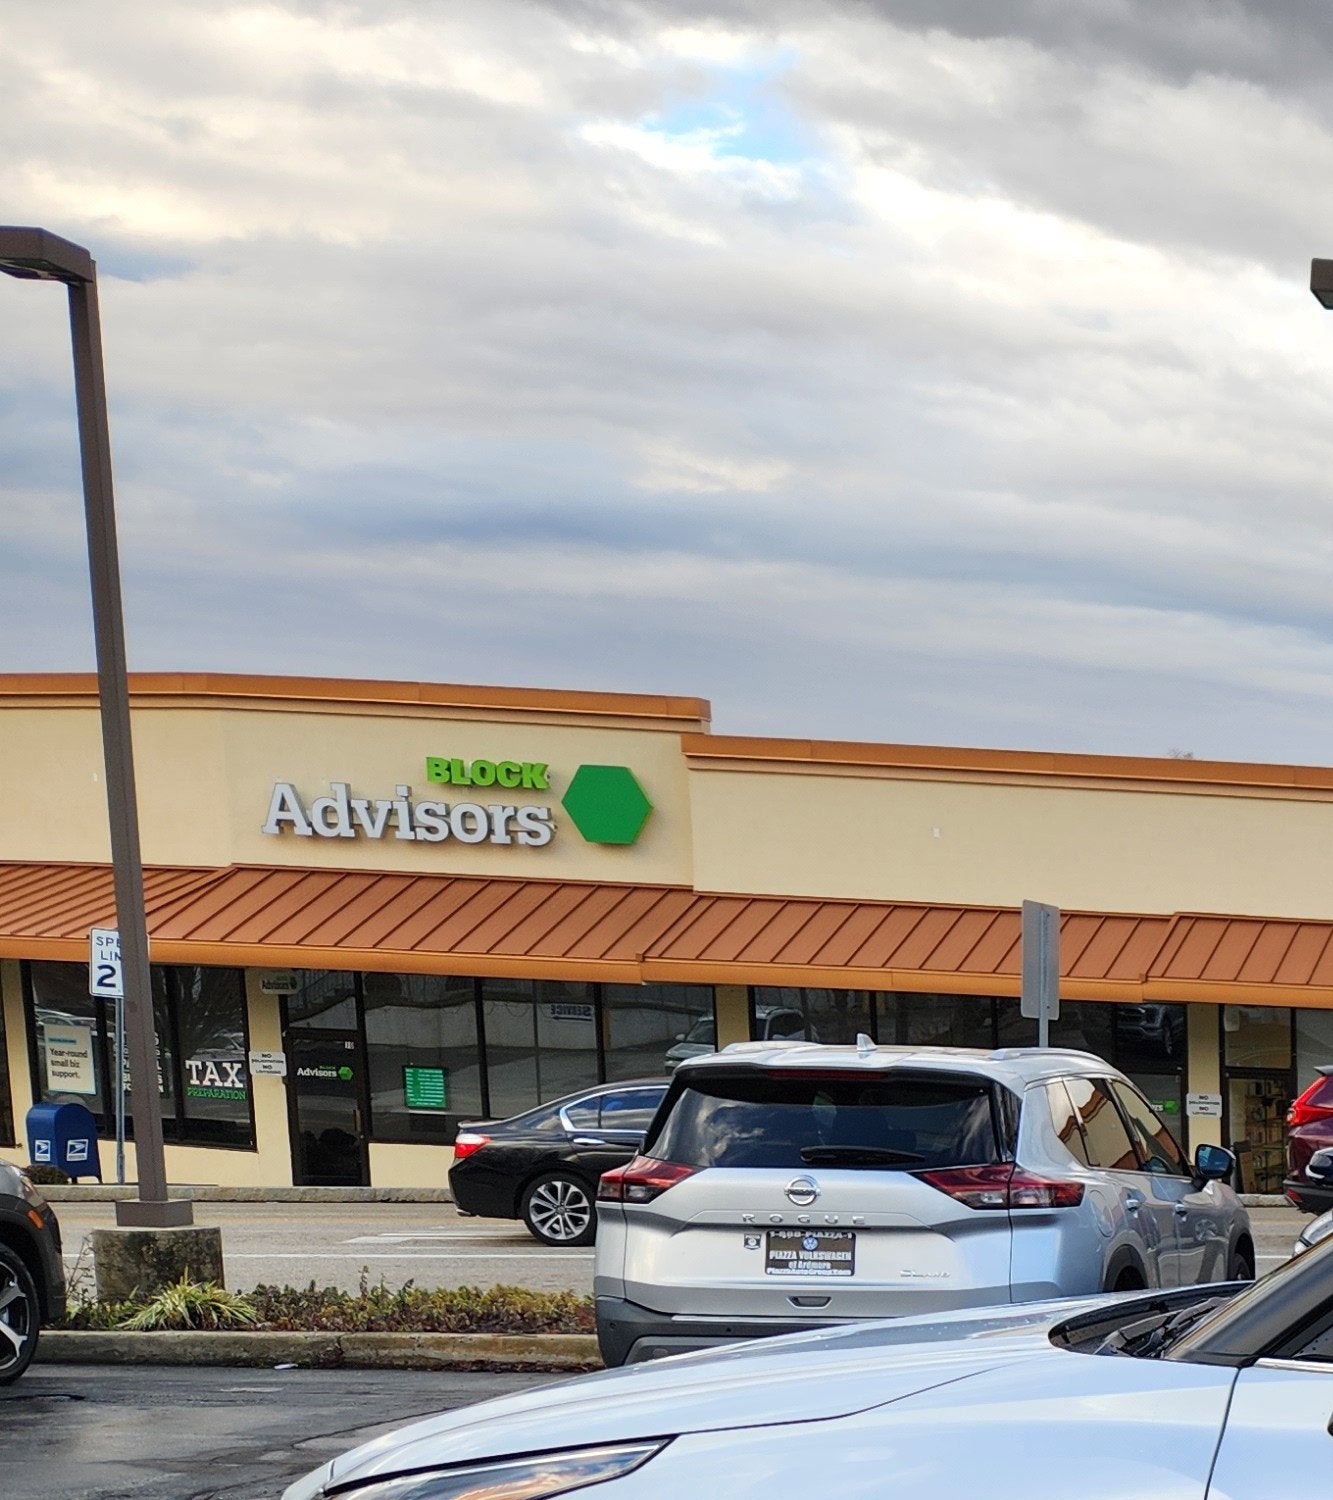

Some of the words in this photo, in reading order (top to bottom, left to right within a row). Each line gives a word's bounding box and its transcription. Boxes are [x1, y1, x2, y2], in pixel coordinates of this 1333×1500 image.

[426, 756, 551, 790] BLOCK
[261, 782, 558, 847] Advisors
[96, 936, 121, 948] SPE
[100, 950, 122, 962] LIM
[96, 964, 117, 988] 2
[50, 1049, 88, 1059] Year-round
[51, 1059, 68, 1068] small
[69, 1060, 80, 1068] biz
[52, 1070, 81, 1080] support.
[185, 1059, 243, 1088] TAX
[297, 1067, 337, 1078] Advisors
[187, 1088, 246, 1100] PREPARATION
[742, 1213, 865, 1225] ROGUE
